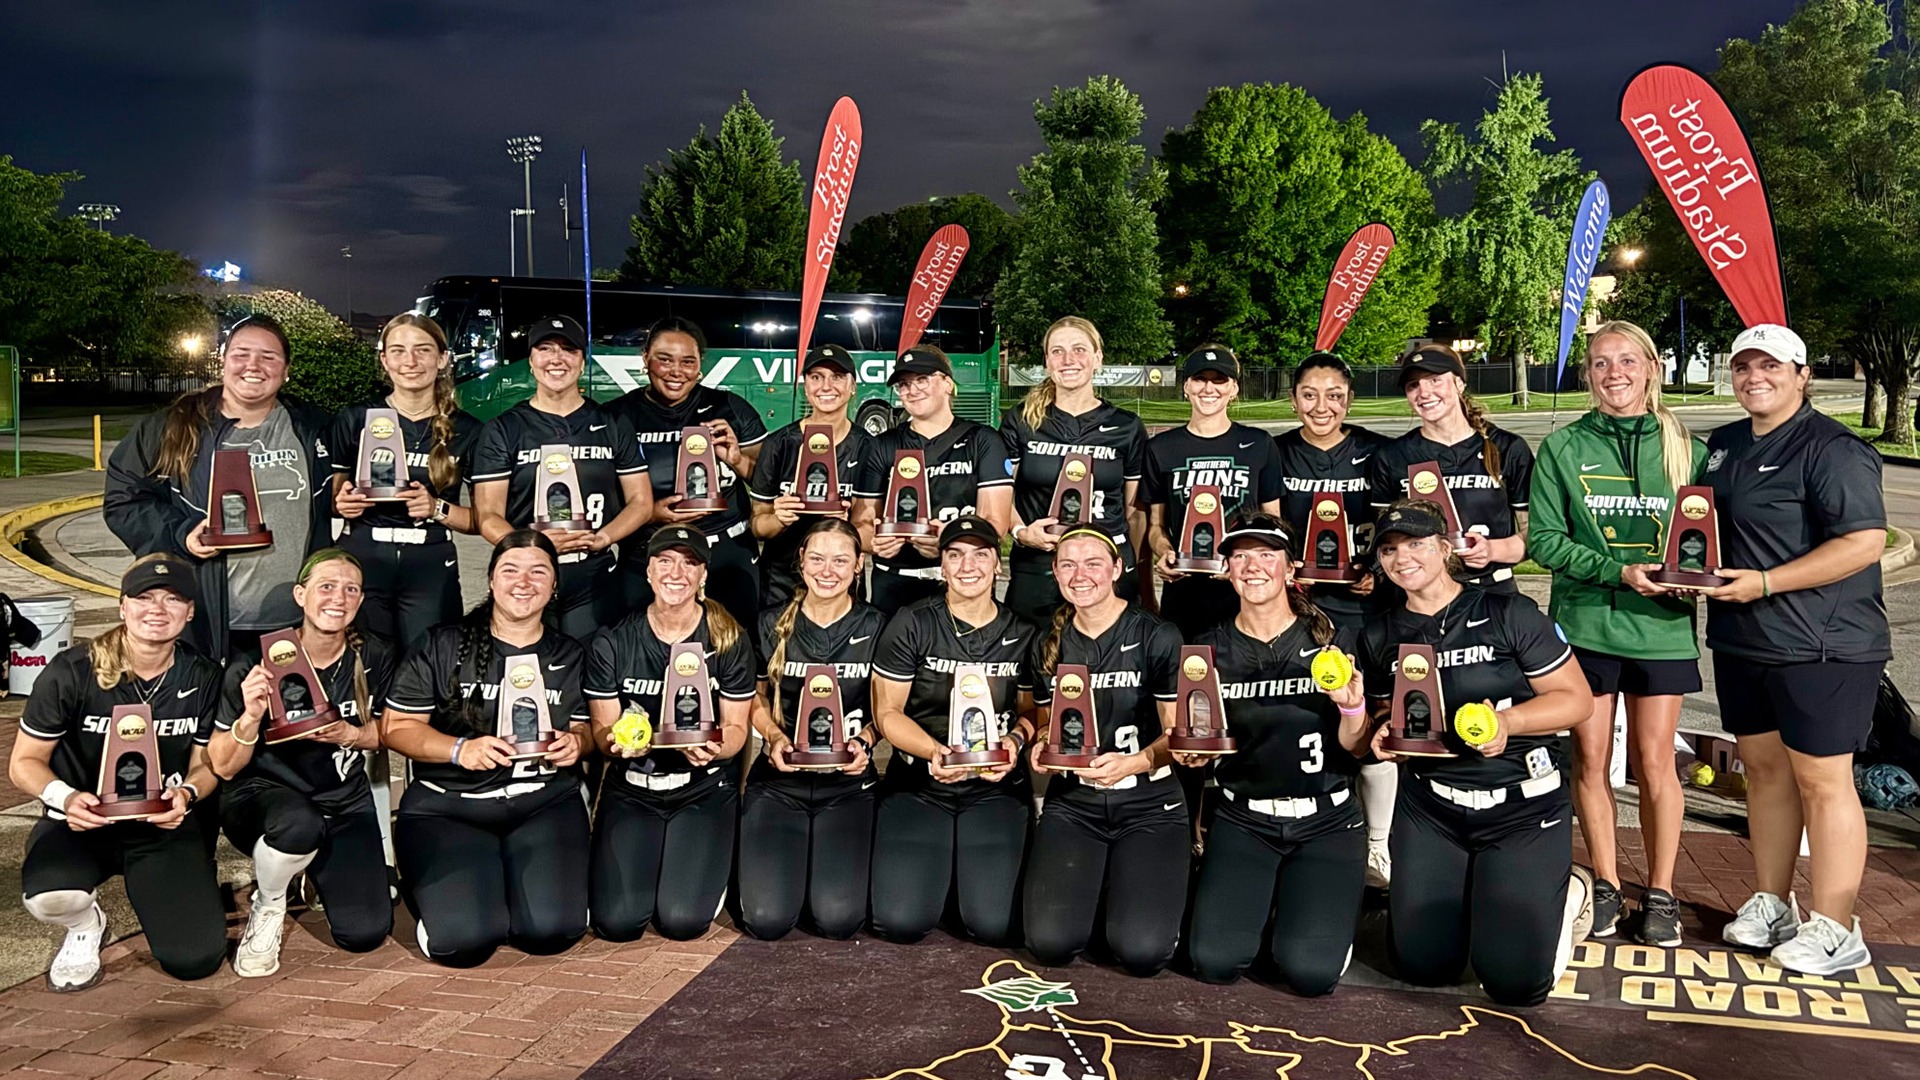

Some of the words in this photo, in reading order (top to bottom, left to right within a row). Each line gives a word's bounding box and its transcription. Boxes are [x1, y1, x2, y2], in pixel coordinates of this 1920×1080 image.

[815, 123, 847, 212] Frost
[815, 139, 859, 271] Stadium
[913, 240, 950, 291] Frost
[1331, 240, 1372, 291] Frost
[1563, 186, 1606, 318] Welcome
[915, 245, 966, 323] Stadium
[1333, 244, 1390, 323] Stadium
[517, 445, 614, 466] SOHERN
[1027, 440, 1117, 461] SOUTHERN
[1192, 460, 1231, 470] SOUTHERN
[1173, 469, 1250, 490] LIONS
[1283, 477, 1372, 494] SOUTHERN
[1583, 494, 1669, 512] SOUTHERN
[1591, 508, 1661, 518] SOFTBALL
[811, 686, 832, 694] NCAA
[1061, 685, 1082, 693] NCAA
[1298, 731, 1325, 775] 3
[1620, 974, 1872, 1025] ROAD
